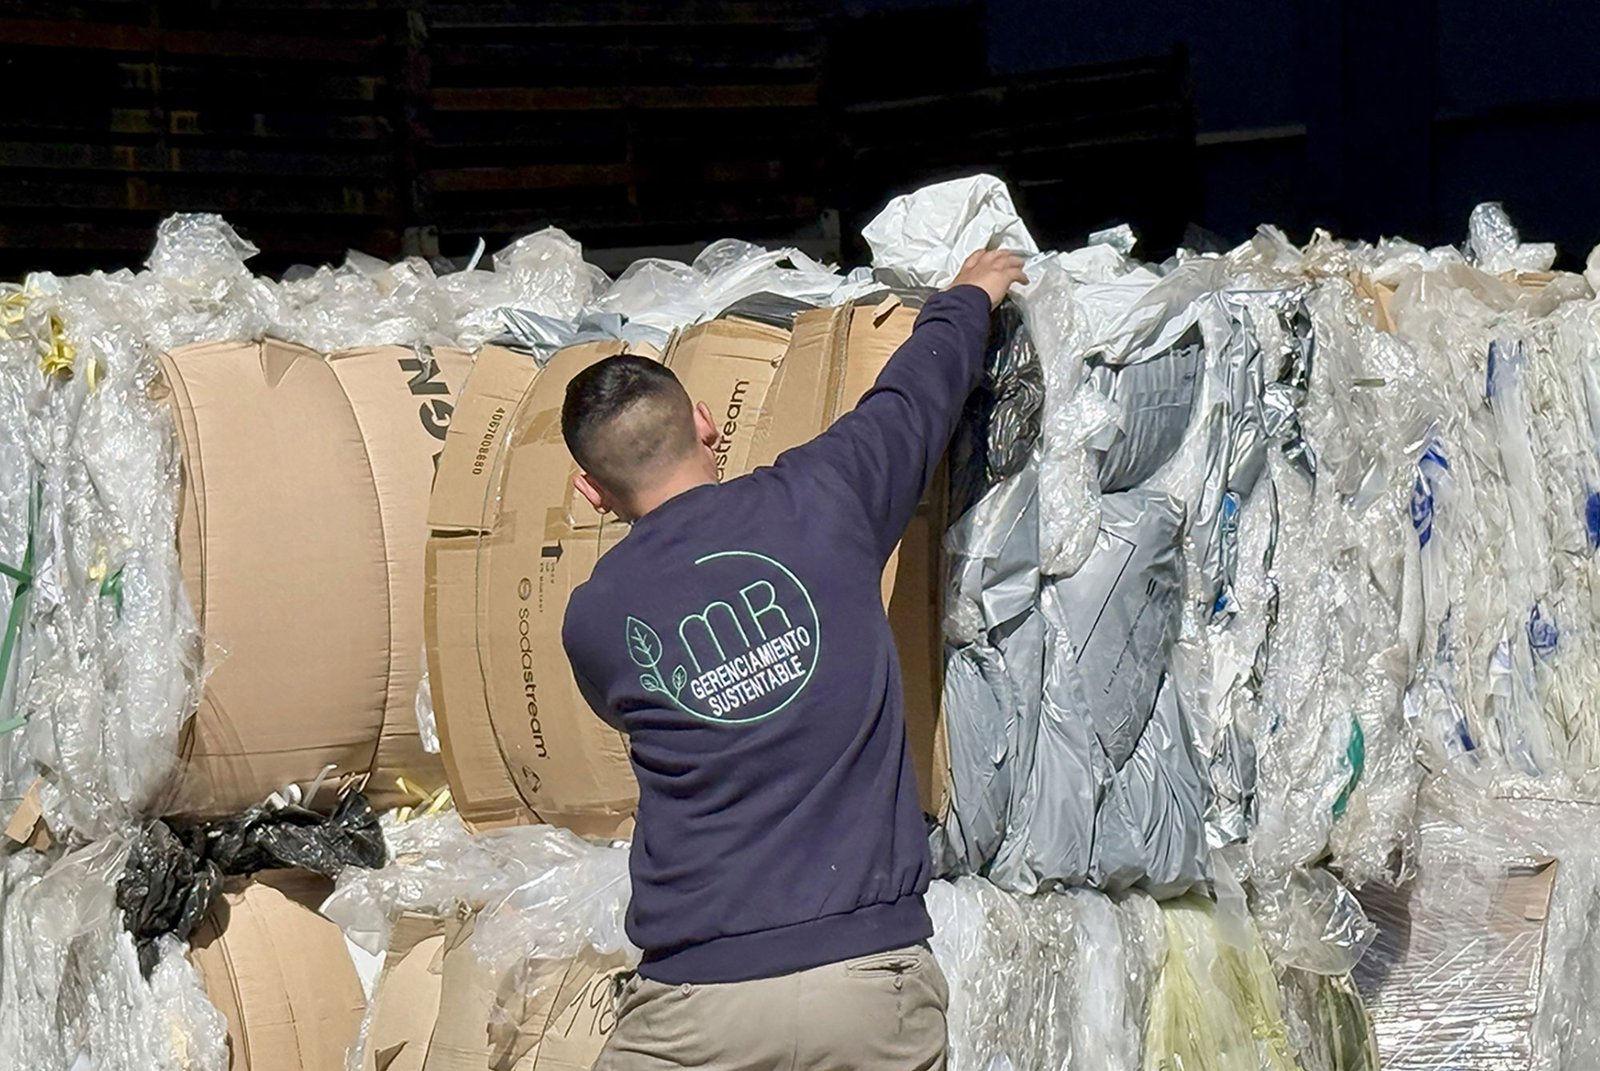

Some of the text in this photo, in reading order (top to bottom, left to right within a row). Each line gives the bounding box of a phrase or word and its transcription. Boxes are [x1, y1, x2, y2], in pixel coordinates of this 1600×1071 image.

[398, 359, 454, 472] GN
[518, 607, 548, 758] sodastream
[690, 626, 811, 700] GERENCIAMIENTO
[708, 655, 806, 717] SUSTENTABLE
